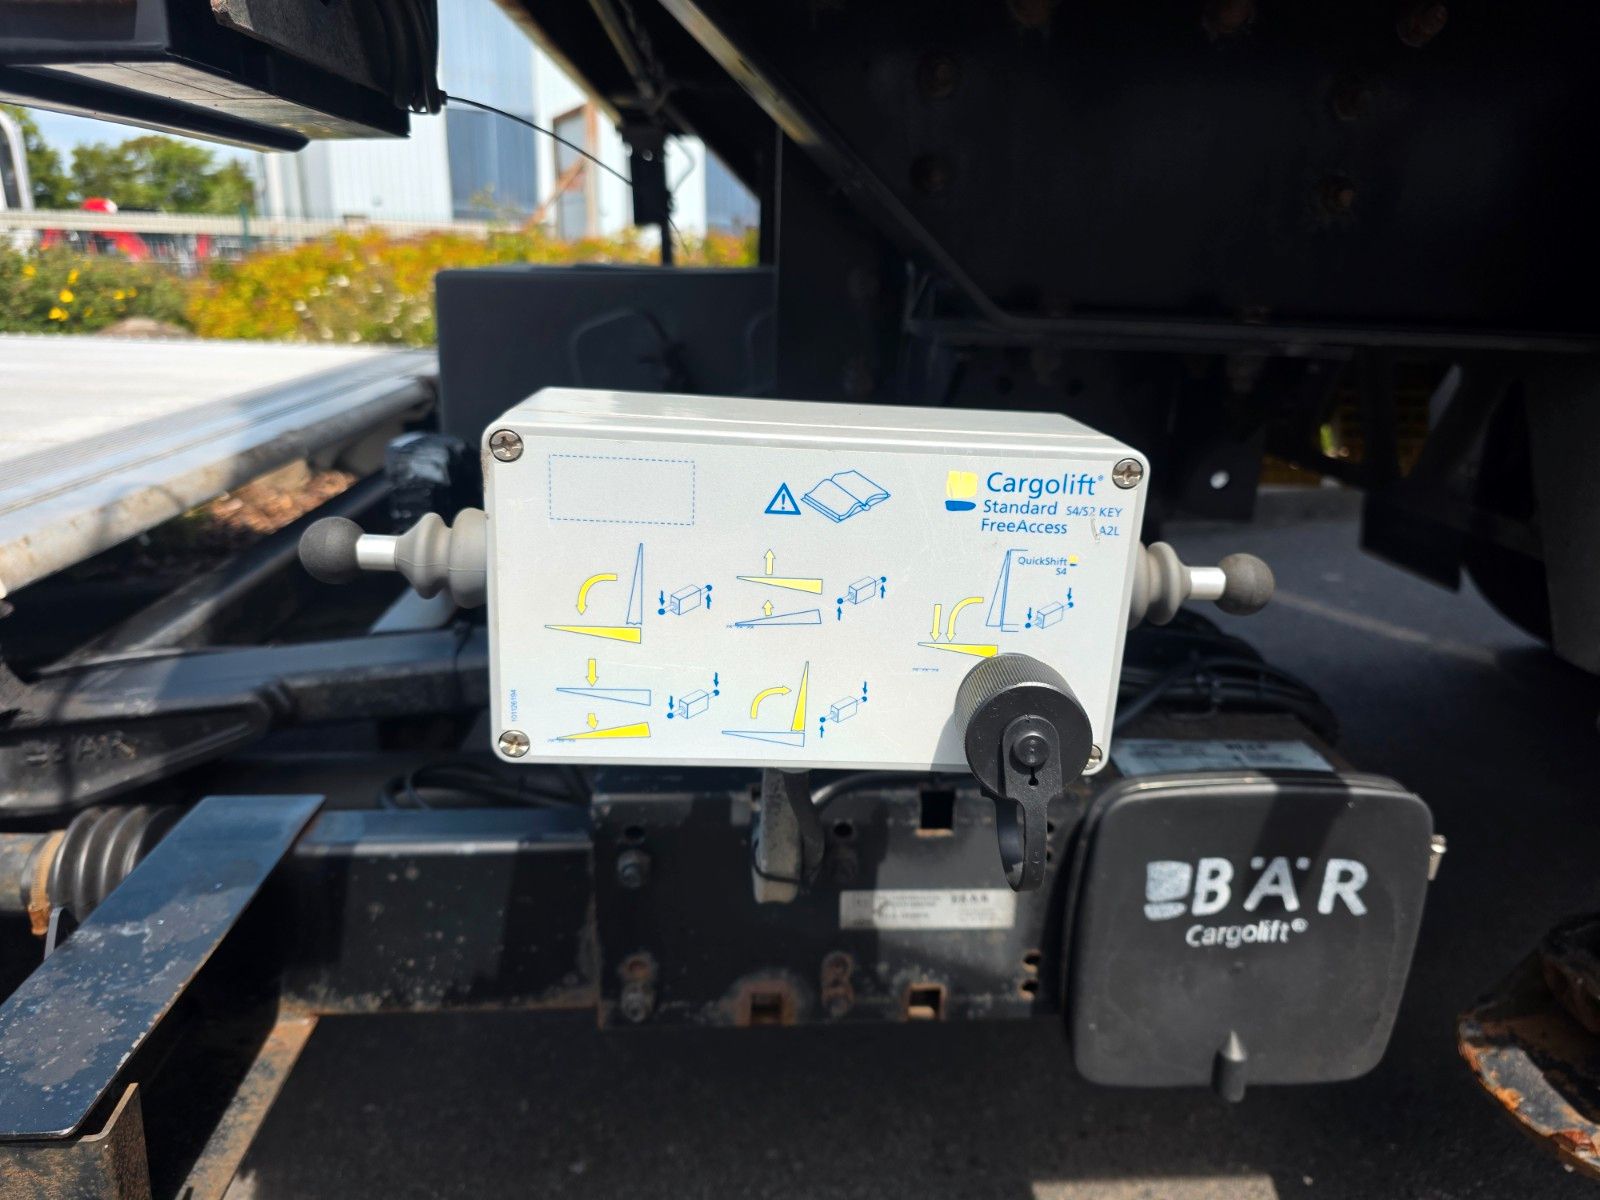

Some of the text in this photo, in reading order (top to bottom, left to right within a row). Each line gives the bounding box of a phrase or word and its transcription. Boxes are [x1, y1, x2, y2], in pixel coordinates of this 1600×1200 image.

[983, 500, 1058, 515] Standard
[1099, 507, 1123, 518] KEY
[981, 518, 1068, 534] FreeAccess
[1099, 525, 1120, 536] A2L
[1018, 556, 1068, 566] QuickShift
[1056, 567, 1067, 576] S4
[1191, 857, 1368, 917] BÄR
